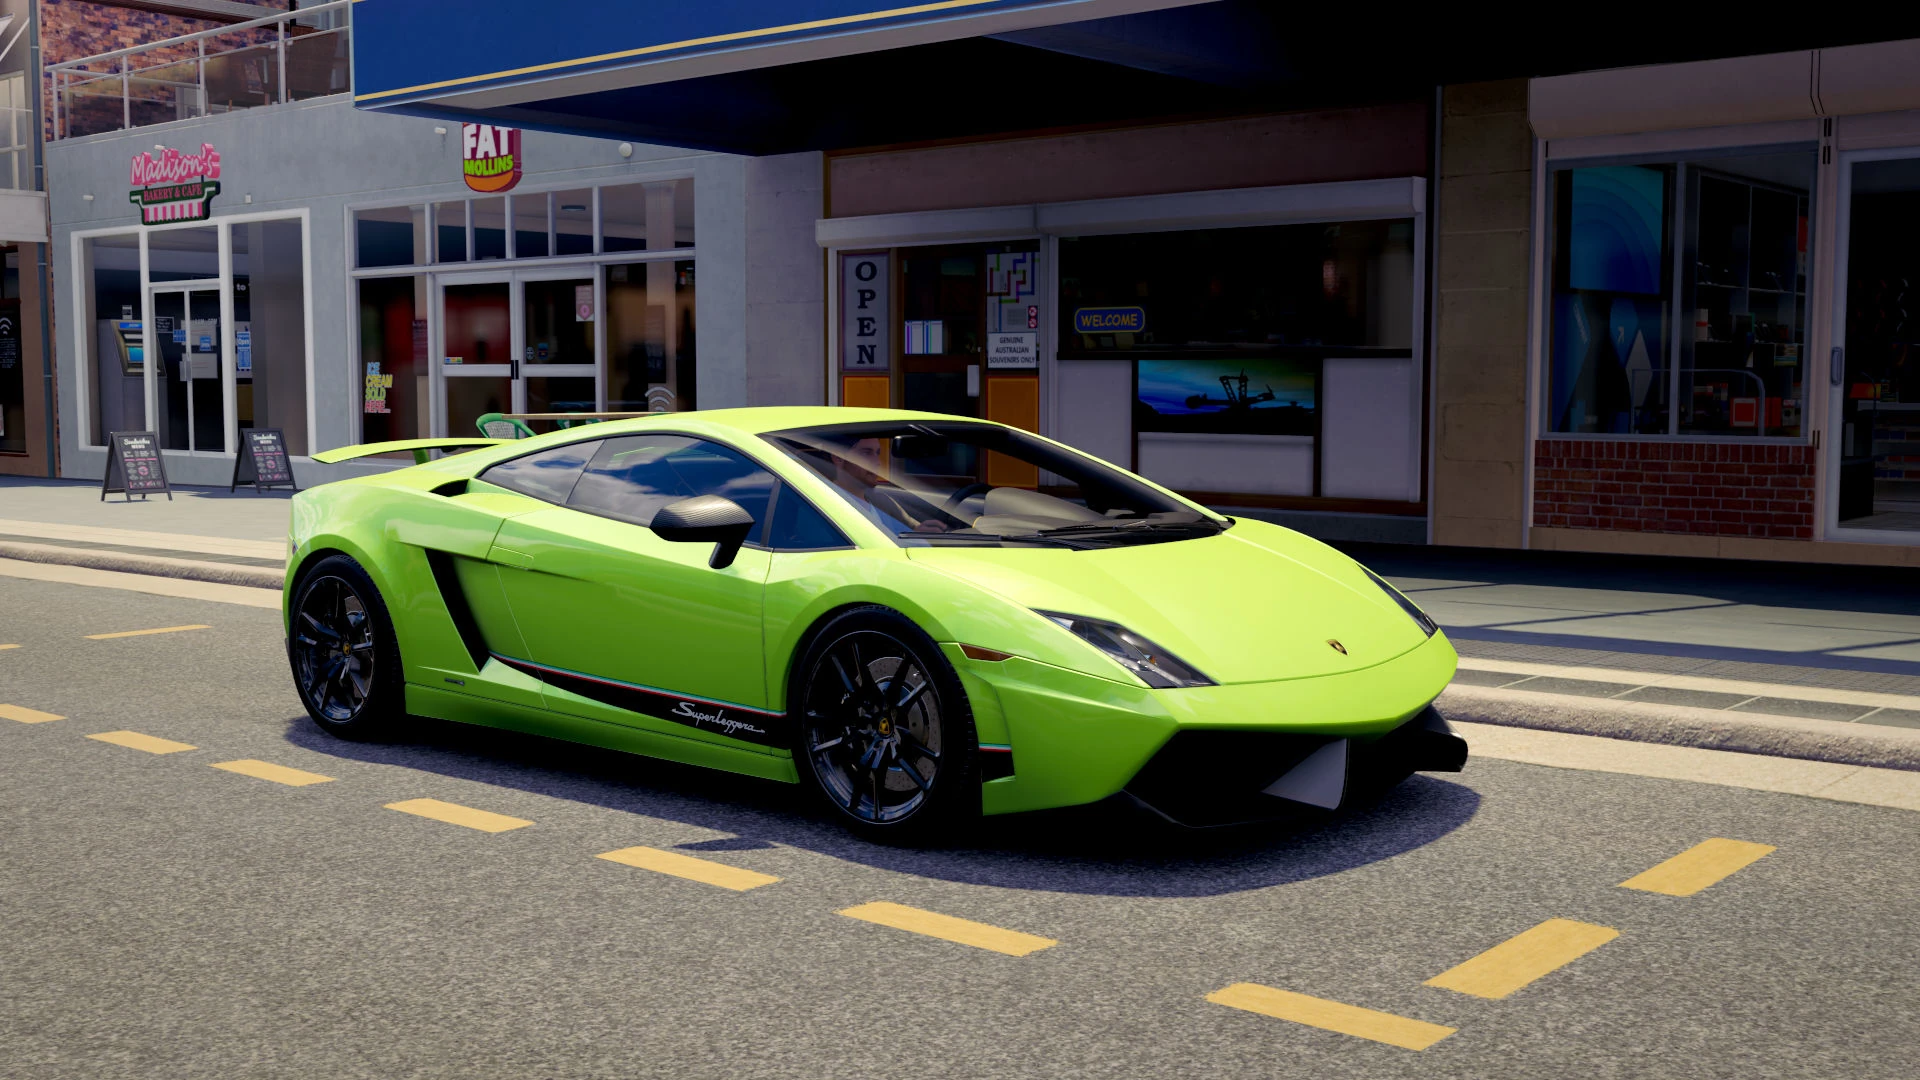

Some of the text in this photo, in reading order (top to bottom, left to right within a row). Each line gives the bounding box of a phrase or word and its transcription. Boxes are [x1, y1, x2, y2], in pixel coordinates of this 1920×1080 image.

[463, 123, 513, 159] FAT
[131, 145, 215, 184] Madison's
[463, 154, 514, 176] MOLLINS
[143, 187, 173, 202] BAKERY
[174, 188, 181, 198] &
[855, 260, 877, 365] OPEN
[1080, 312, 1138, 327] WELCOME
[999, 336, 1025, 344] GENUINE
[995, 346, 1030, 354] AUSTRALIAN
[989, 355, 1036, 364] SOUVENIRS ONLY
[366, 361, 381, 375] ICE
[365, 373, 393, 388] CREAM
[364, 386, 387, 401] SOLD
[671, 701, 766, 734] Superleggera
